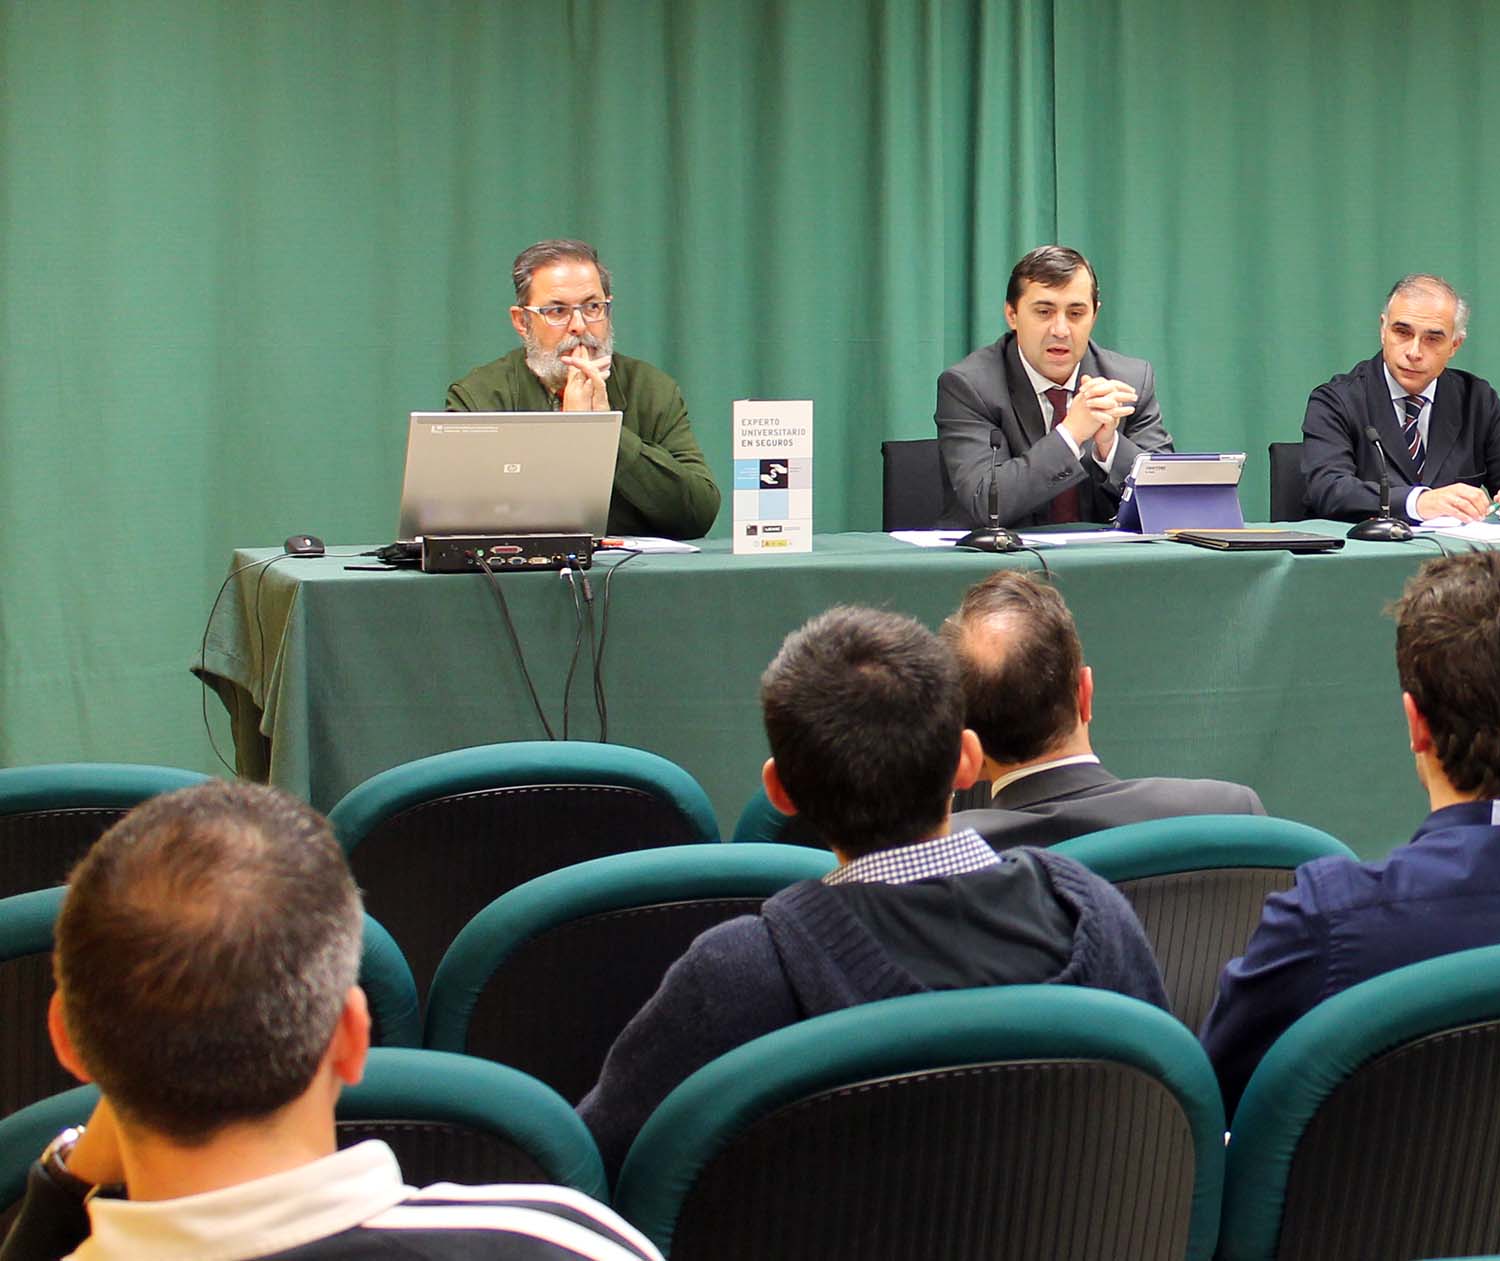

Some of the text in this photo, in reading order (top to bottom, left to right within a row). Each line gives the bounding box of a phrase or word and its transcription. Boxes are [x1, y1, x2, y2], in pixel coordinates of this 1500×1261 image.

[741, 418, 780, 426] EXPERTO
[741, 428, 806, 437] UNIVERSITARIO
[741, 439, 793, 447] EN SEGUROS
